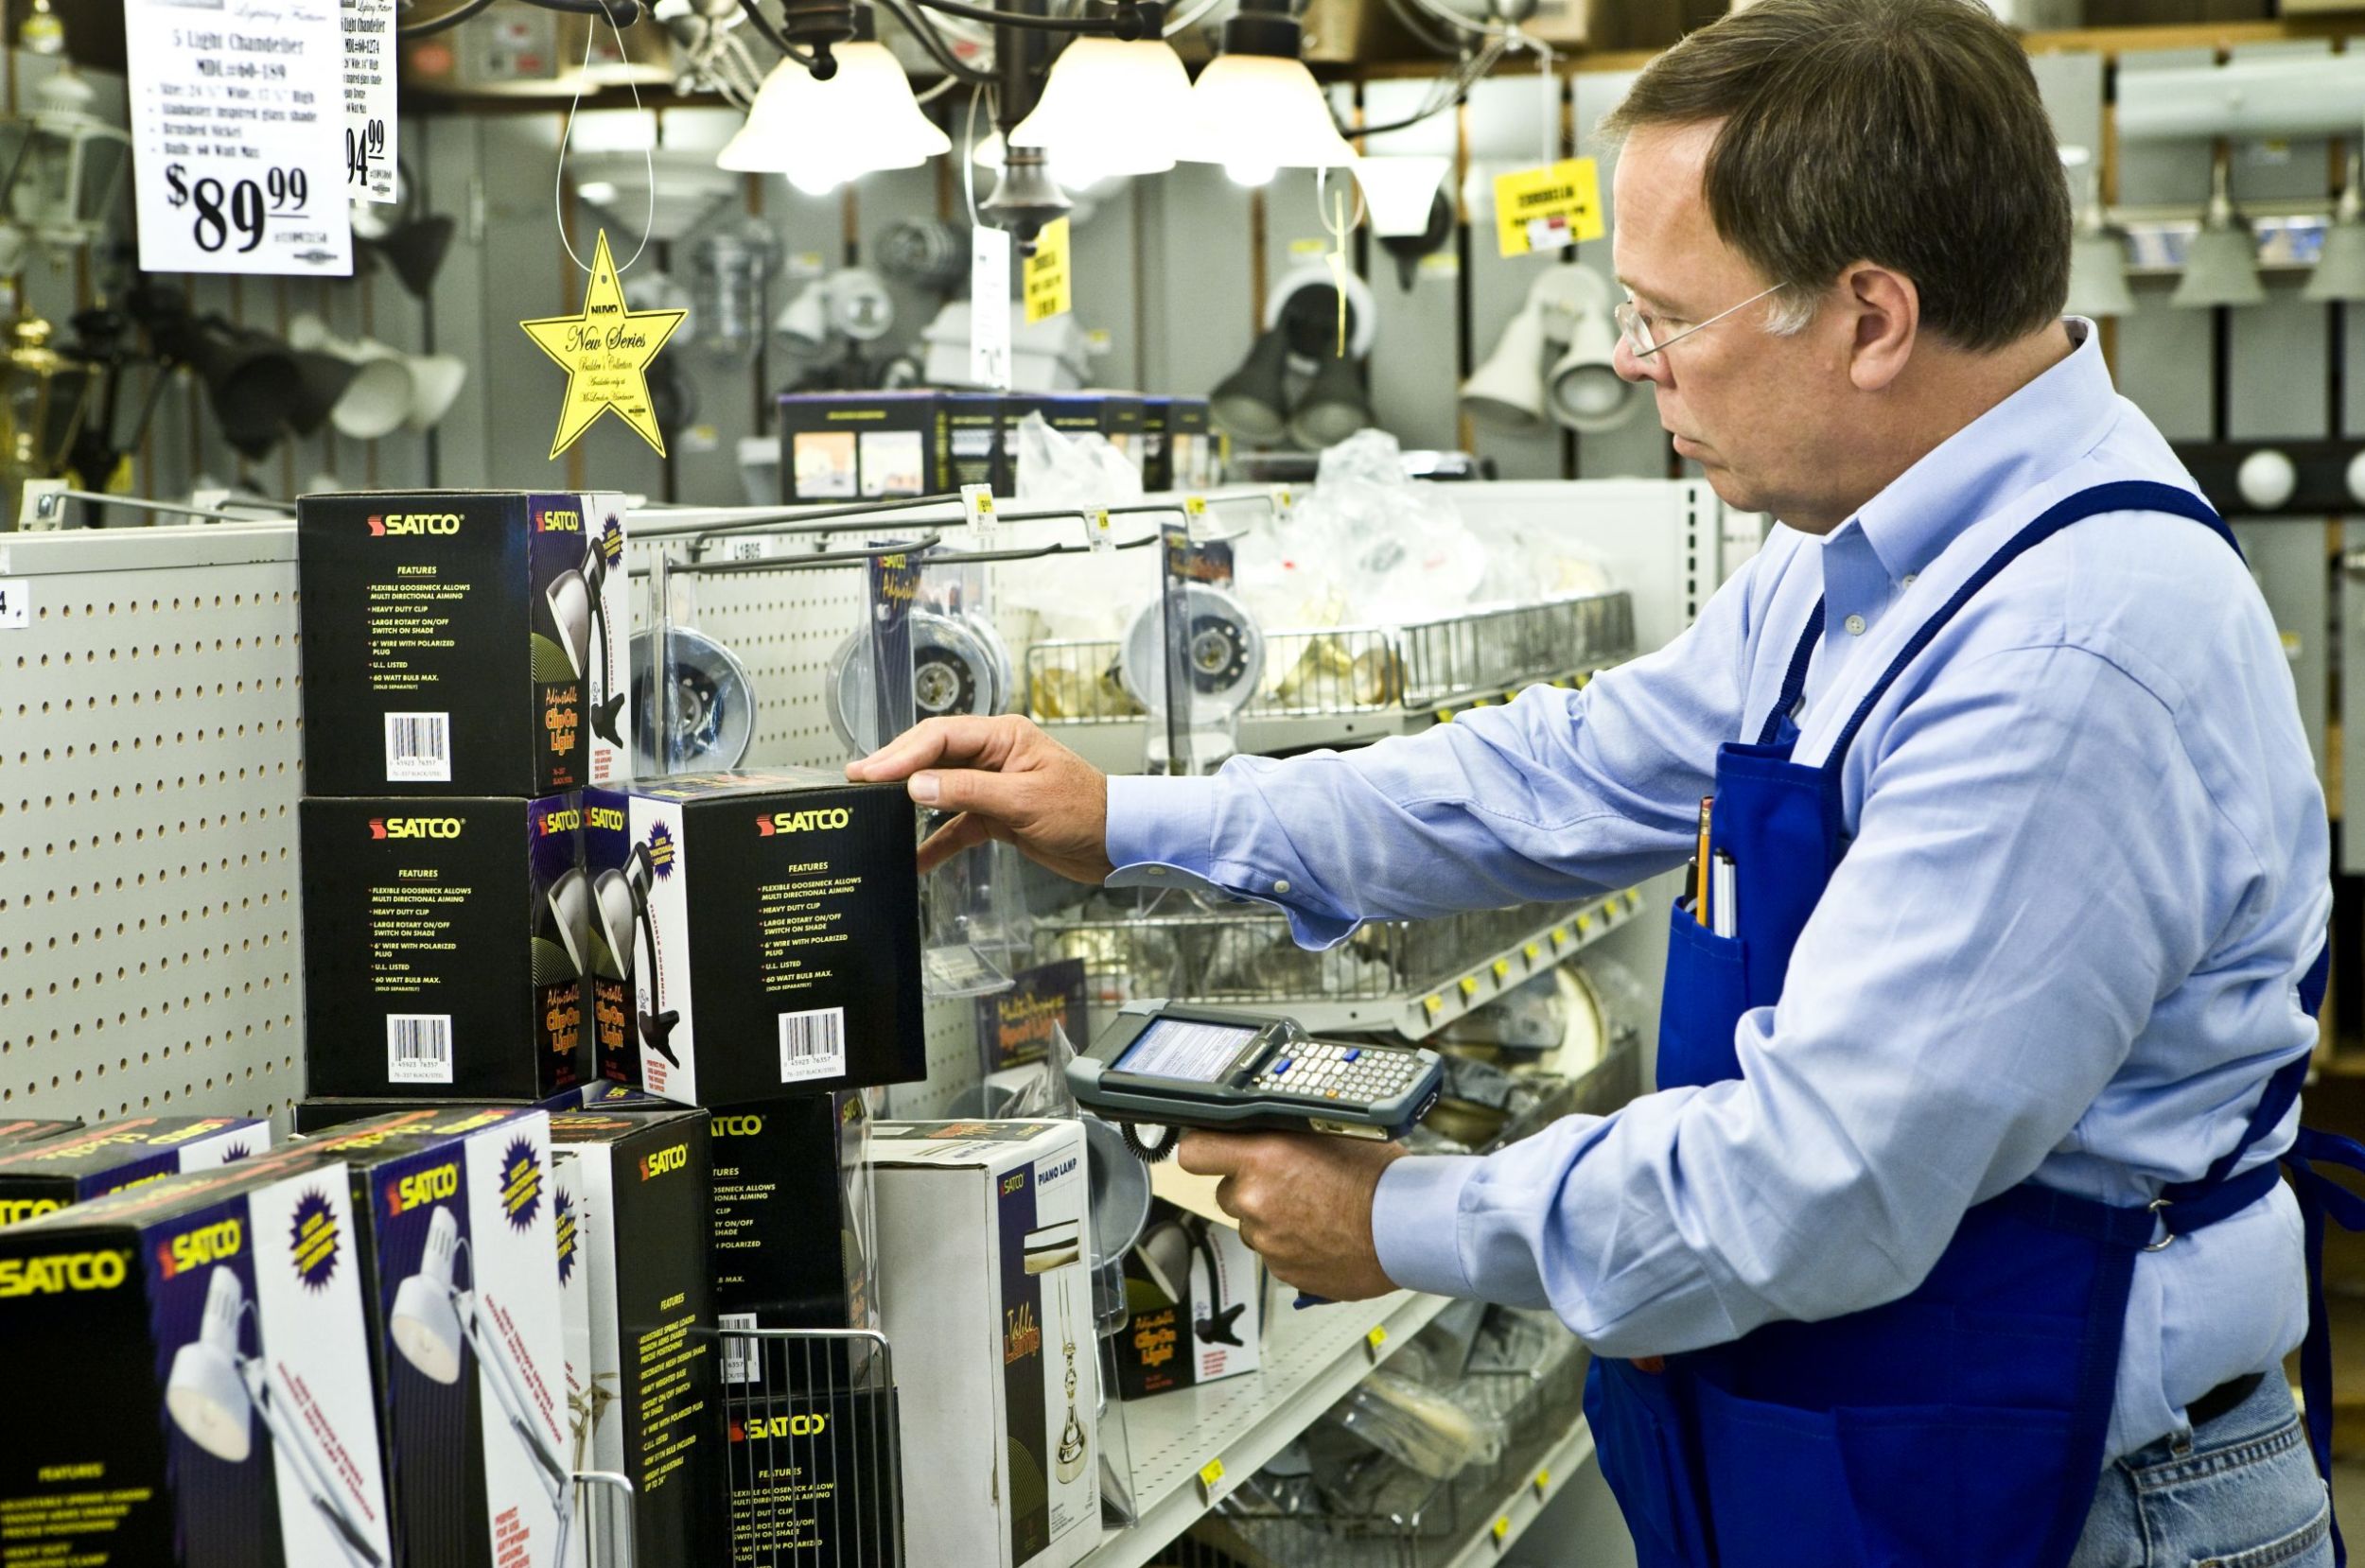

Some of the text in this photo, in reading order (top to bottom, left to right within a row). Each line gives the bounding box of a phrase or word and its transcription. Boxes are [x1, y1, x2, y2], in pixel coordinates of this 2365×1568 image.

[591, 305, 618, 313] NUVO
[566, 323, 645, 356] New Series
[385, 514, 460, 535] SATCO
[545, 511, 578, 531] SATCO
[397, 566, 437, 575] FEATURES
[387, 817, 462, 838] SATCO
[547, 809, 580, 835] SATCO
[590, 807, 623, 831] SATCO
[774, 808, 850, 834] SATCO
[788, 862, 828, 872] FEATURES
[762, 877, 862, 892] FLEXIBLE GOOSENECK ALLOWS
[783, 889, 827, 898] DIRECTIONAL
[828, 886, 854, 895] AIMING
[787, 916, 813, 925] ROTARY
[815, 914, 841, 922] ON/OFF
[764, 927, 790, 935] SWITCH
[811, 934, 848, 944] POLARIZED
[796, 971, 813, 980] BULB
[648, 1144, 686, 1177] SATCO
[1038, 1158, 1077, 1186] PIANO LAMP
[400, 1163, 458, 1211] SATCO
[1004, 1174, 1024, 1194] SATCO
[725, 1219, 753, 1228] ON/OFF
[172, 1219, 241, 1273] SATCO
[0, 1249, 126, 1298] SATCO
[661, 1293, 685, 1311] FEATURES
[692, 1344, 707, 1357] SHADE
[745, 1414, 825, 1439] SATCO
